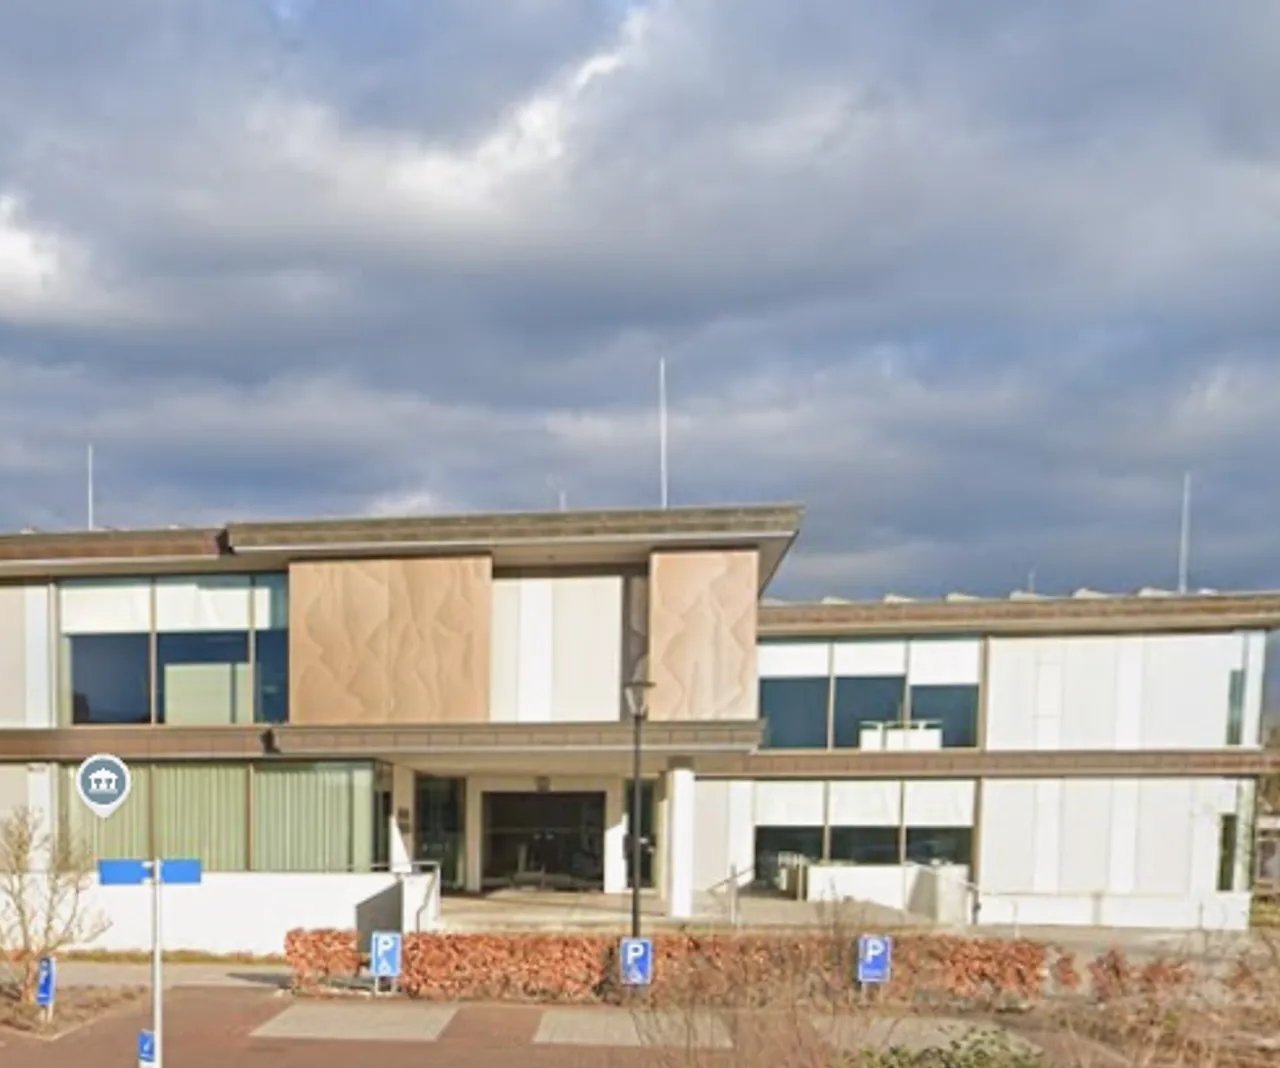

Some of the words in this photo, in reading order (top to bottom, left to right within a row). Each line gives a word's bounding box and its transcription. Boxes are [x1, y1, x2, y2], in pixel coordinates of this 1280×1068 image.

[378, 934, 394, 958] P
[627, 944, 644, 965] P
[866, 939, 885, 964] P
